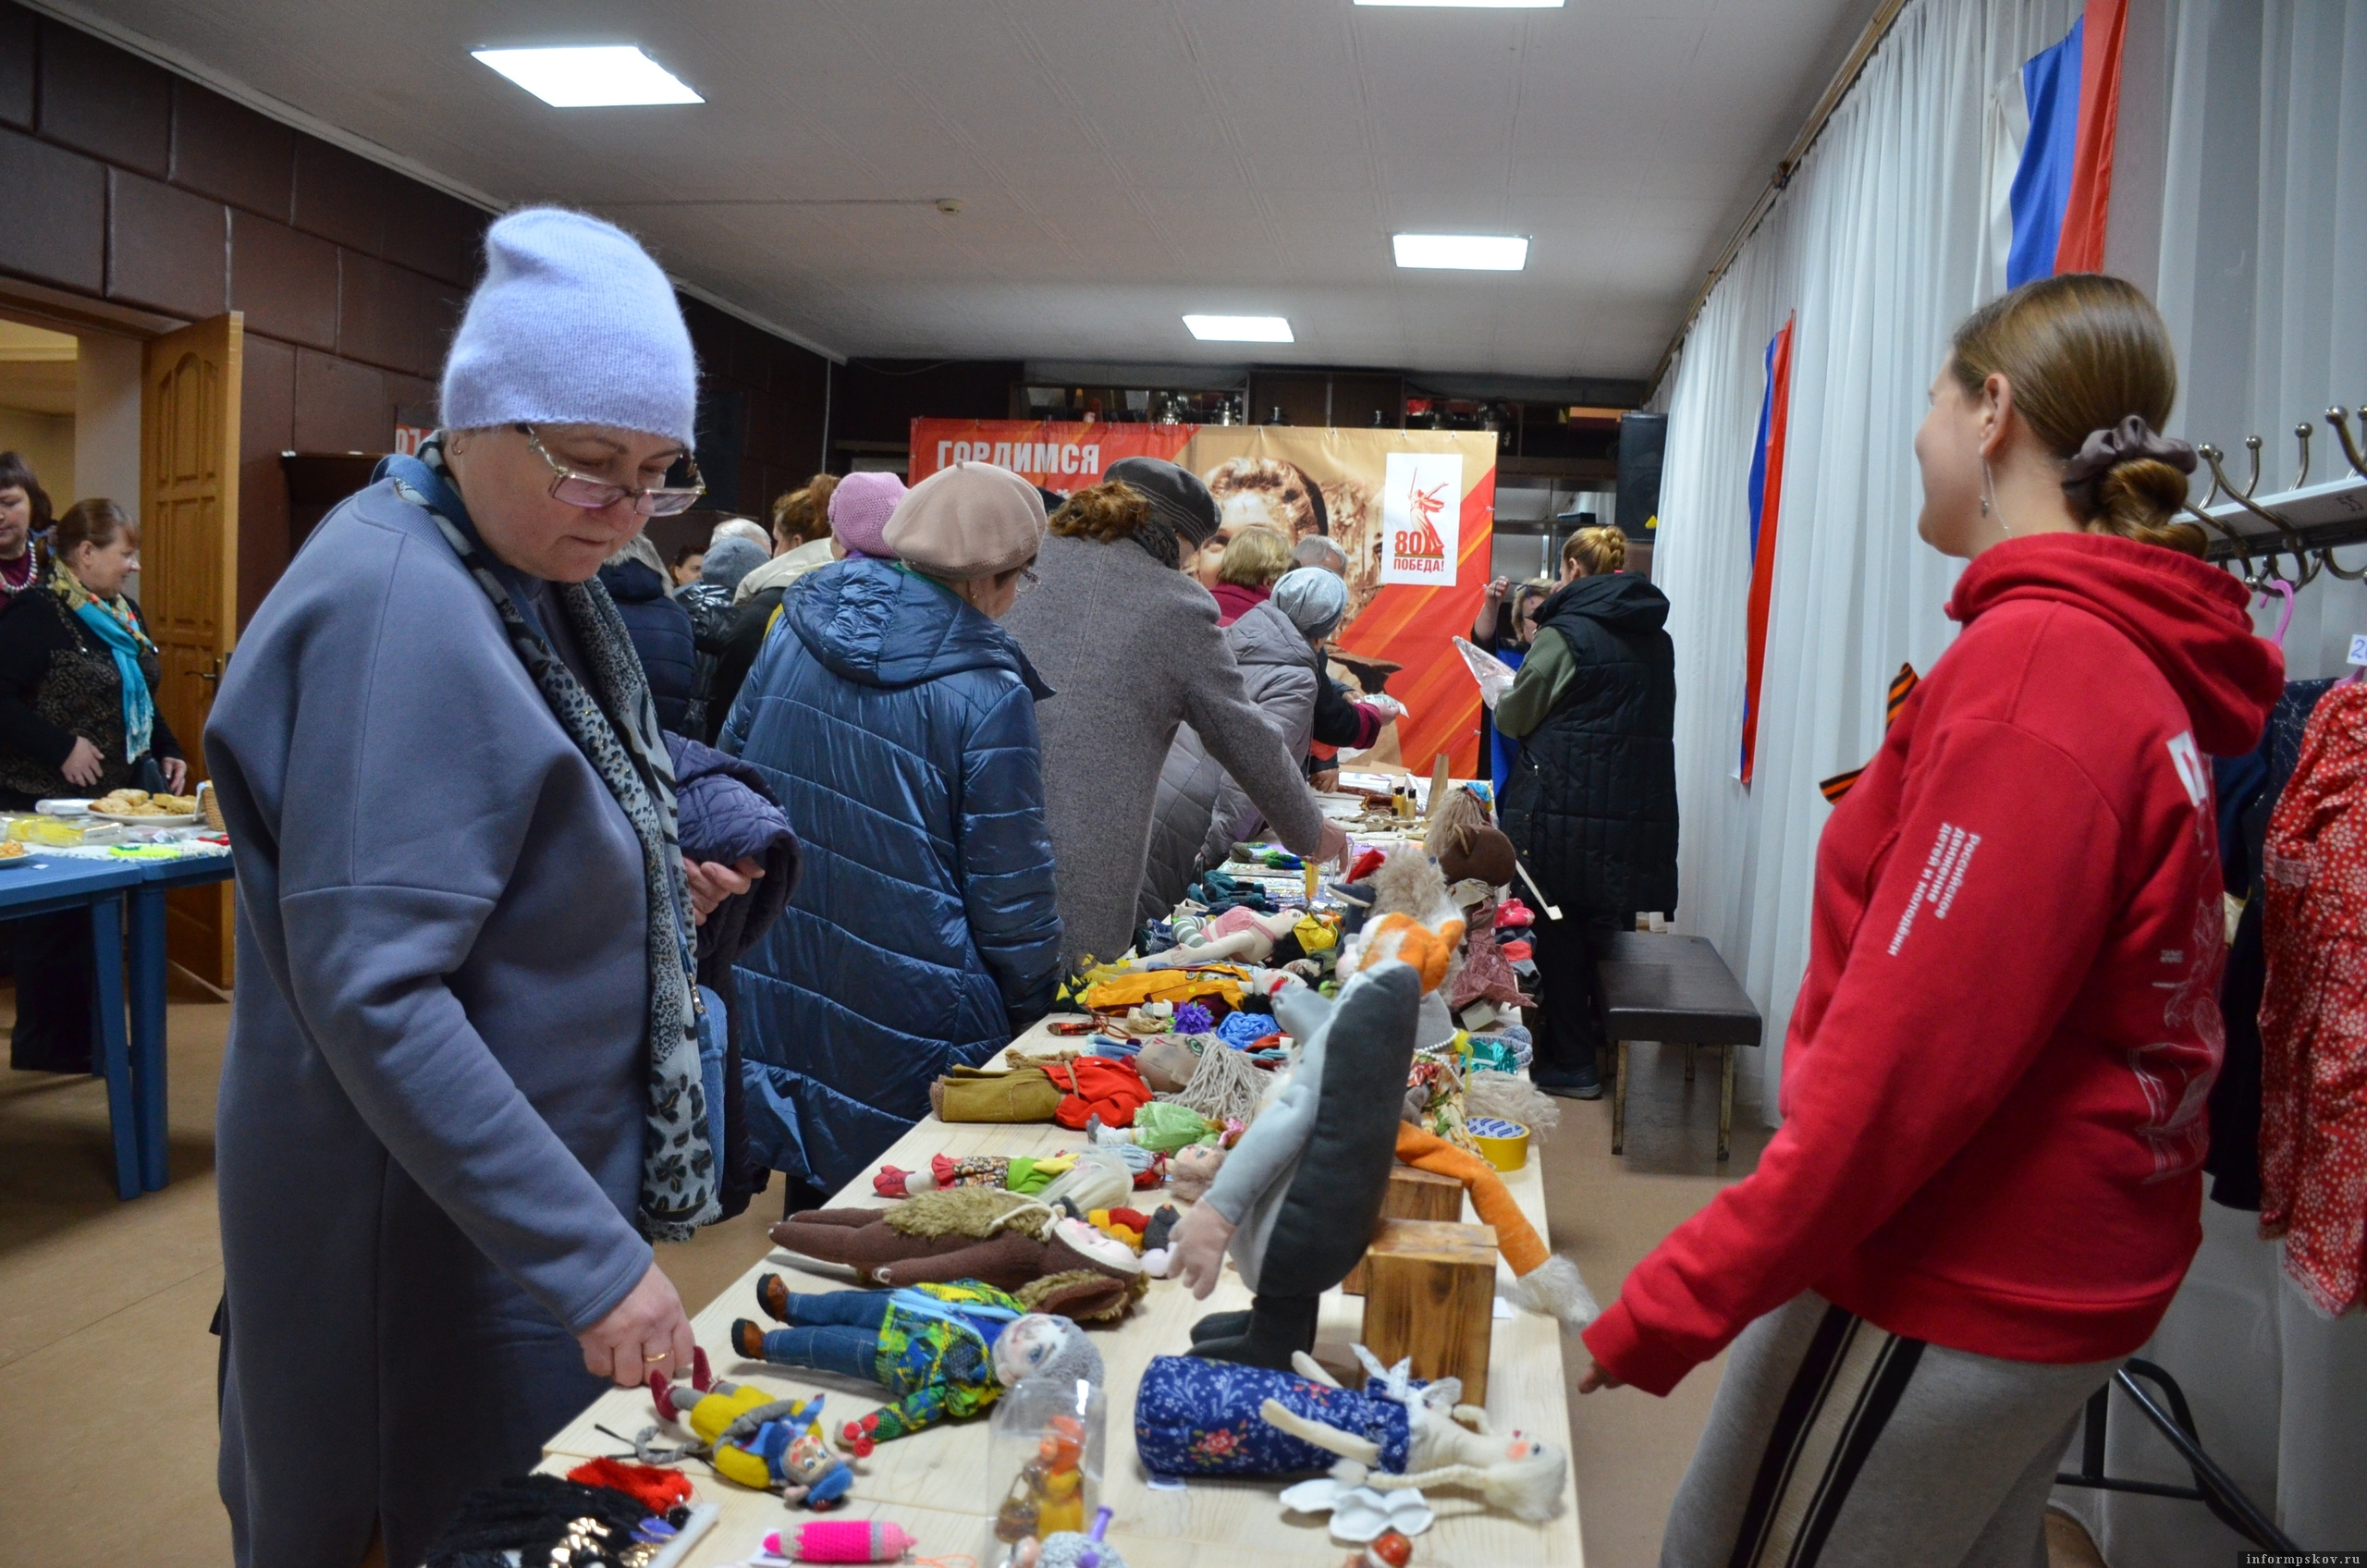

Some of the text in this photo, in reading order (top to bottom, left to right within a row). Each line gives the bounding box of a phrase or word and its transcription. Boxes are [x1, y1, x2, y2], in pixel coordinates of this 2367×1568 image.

[937, 440, 1100, 474] ГОРДИМСЯ
[1394, 530, 1422, 555] 80
[1393, 557, 1444, 573] ПОБЕДА!
[1927, 823, 1952, 867] детей
[1921, 867, 1933, 880] и
